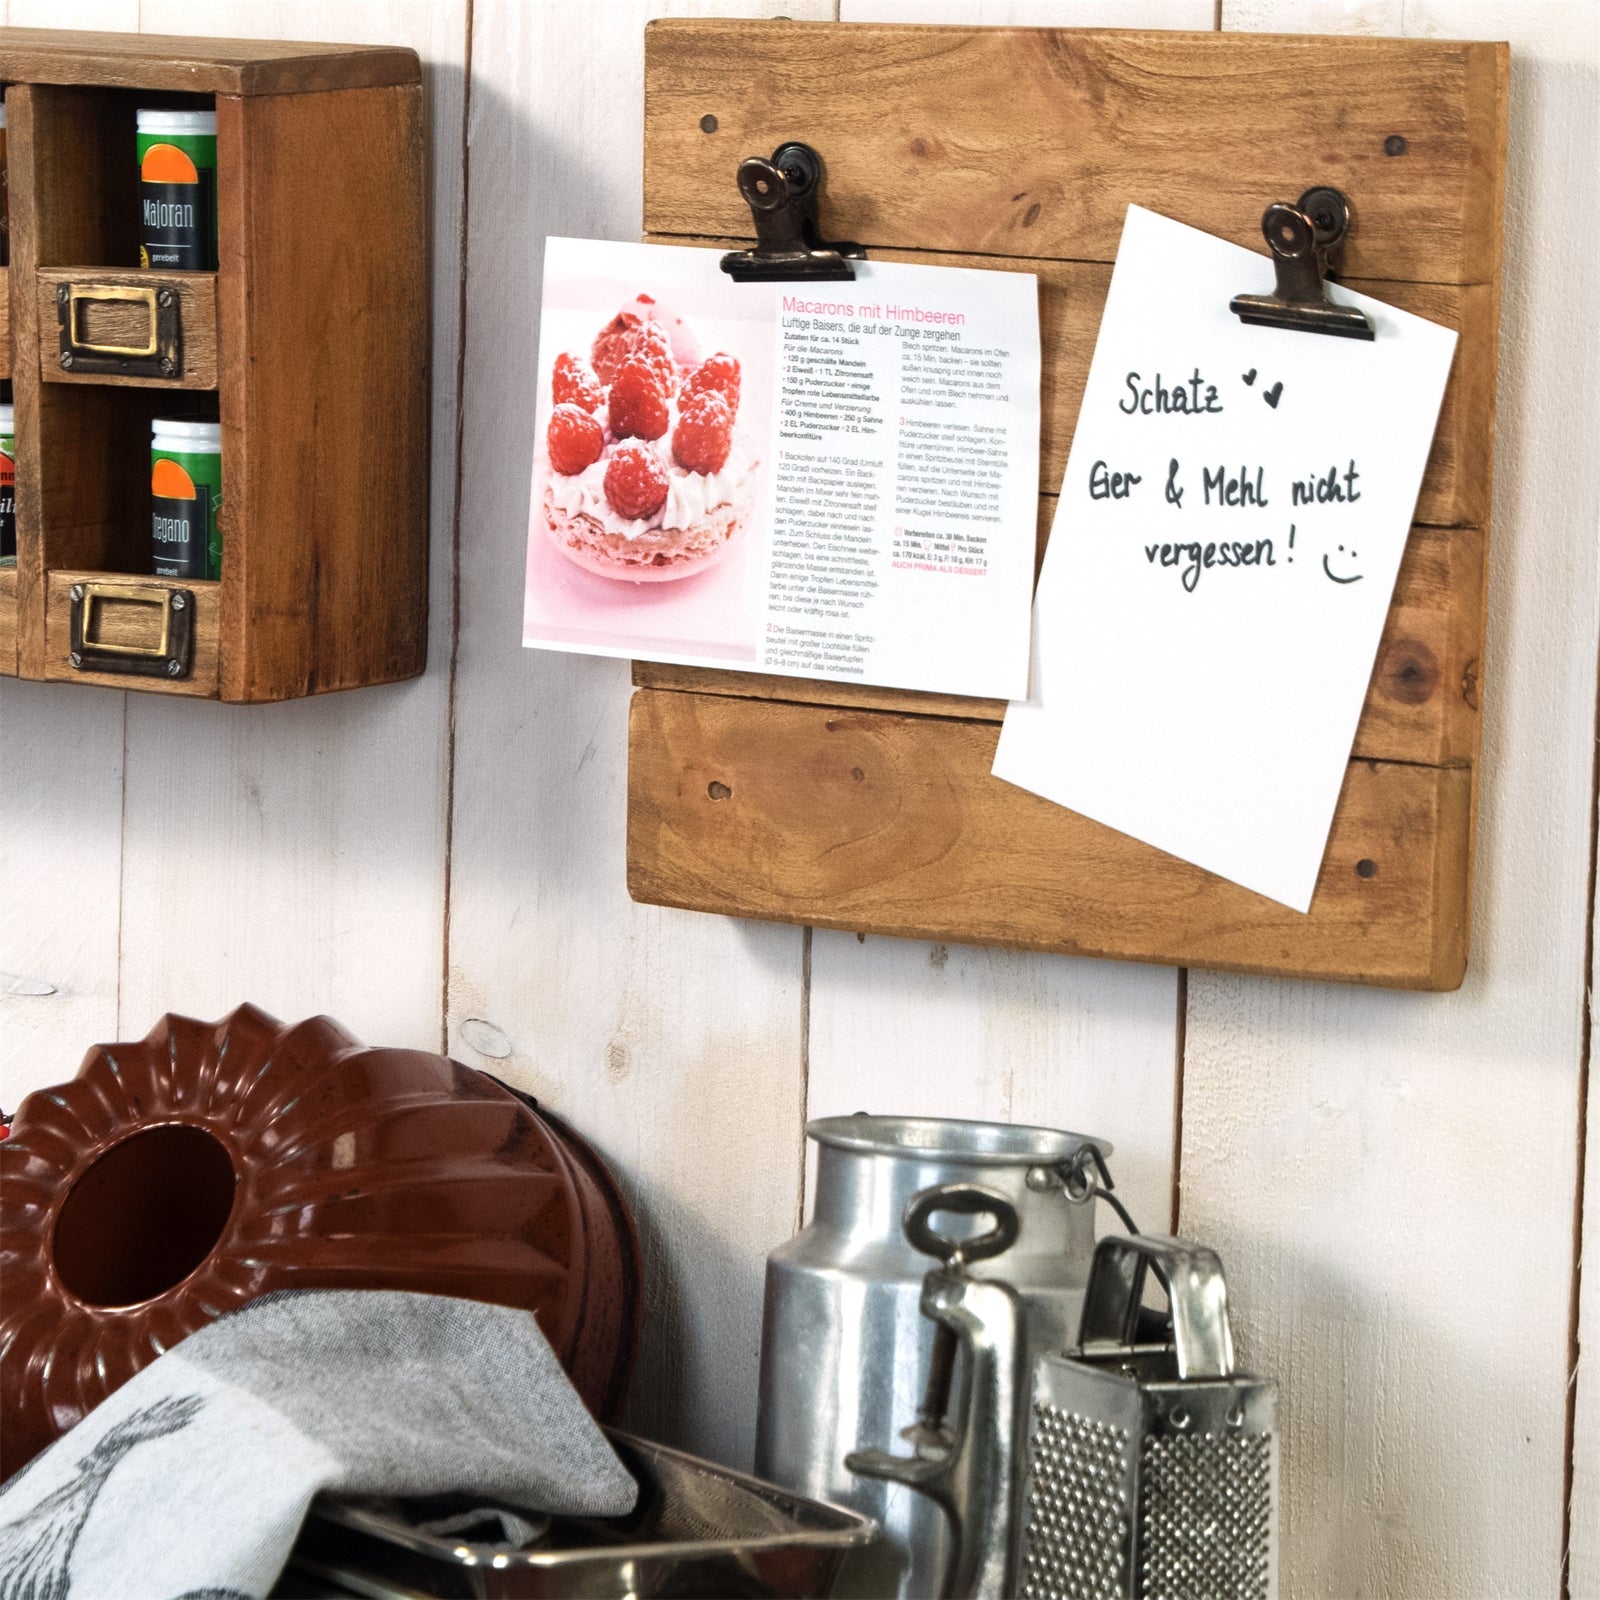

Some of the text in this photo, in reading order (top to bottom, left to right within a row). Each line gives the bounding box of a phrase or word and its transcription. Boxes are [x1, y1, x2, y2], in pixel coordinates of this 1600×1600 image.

[143, 199, 193, 228] Majoran
[783, 296, 965, 325] Macarons mit Himbeeren
[782, 317, 960, 342] Luftige Baisers, die auf der Zunge zergehen
[784, 332, 808, 341] Zutaten
[809, 346, 843, 355] Macarons
[806, 357, 837, 365] geschälte
[834, 369, 873, 379] Zitronensaft
[805, 378, 845, 387] Puderzucker
[851, 382, 870, 391] einige
[782, 387, 805, 395] Tropfen
[822, 391, 880, 401] Lebensmittelfarbe
[1119, 368, 1223, 415] Schatz
[834, 403, 871, 414] Verzierung
[804, 411, 838, 420] Himbeeren
[800, 421, 840, 430] Puderzucker
[780, 431, 822, 440] beerkonfitüre
[1089, 457, 1361, 509] Eier & Mehl nicht
[914, 562, 936, 571] PRIMA
[954, 567, 987, 576] DESSERT
